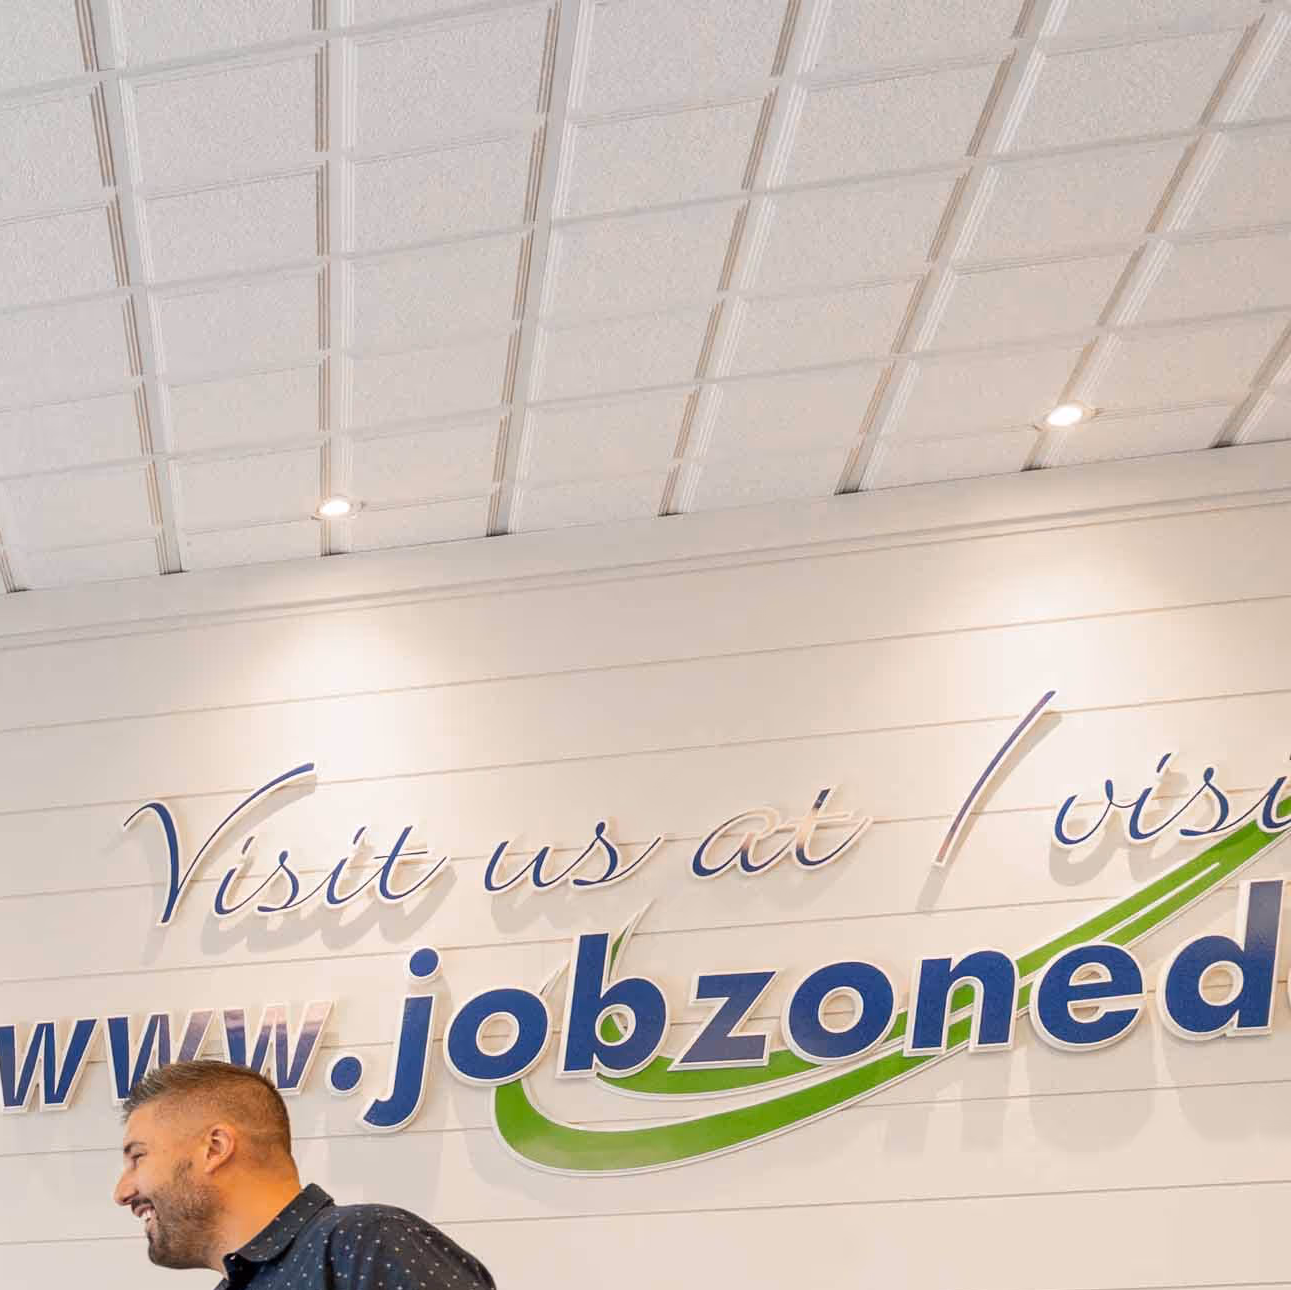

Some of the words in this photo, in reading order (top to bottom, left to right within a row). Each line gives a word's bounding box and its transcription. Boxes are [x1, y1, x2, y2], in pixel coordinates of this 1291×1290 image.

[122, 761, 443, 925] Visit
[482, 817, 662, 889] us
[691, 787, 870, 876] at
